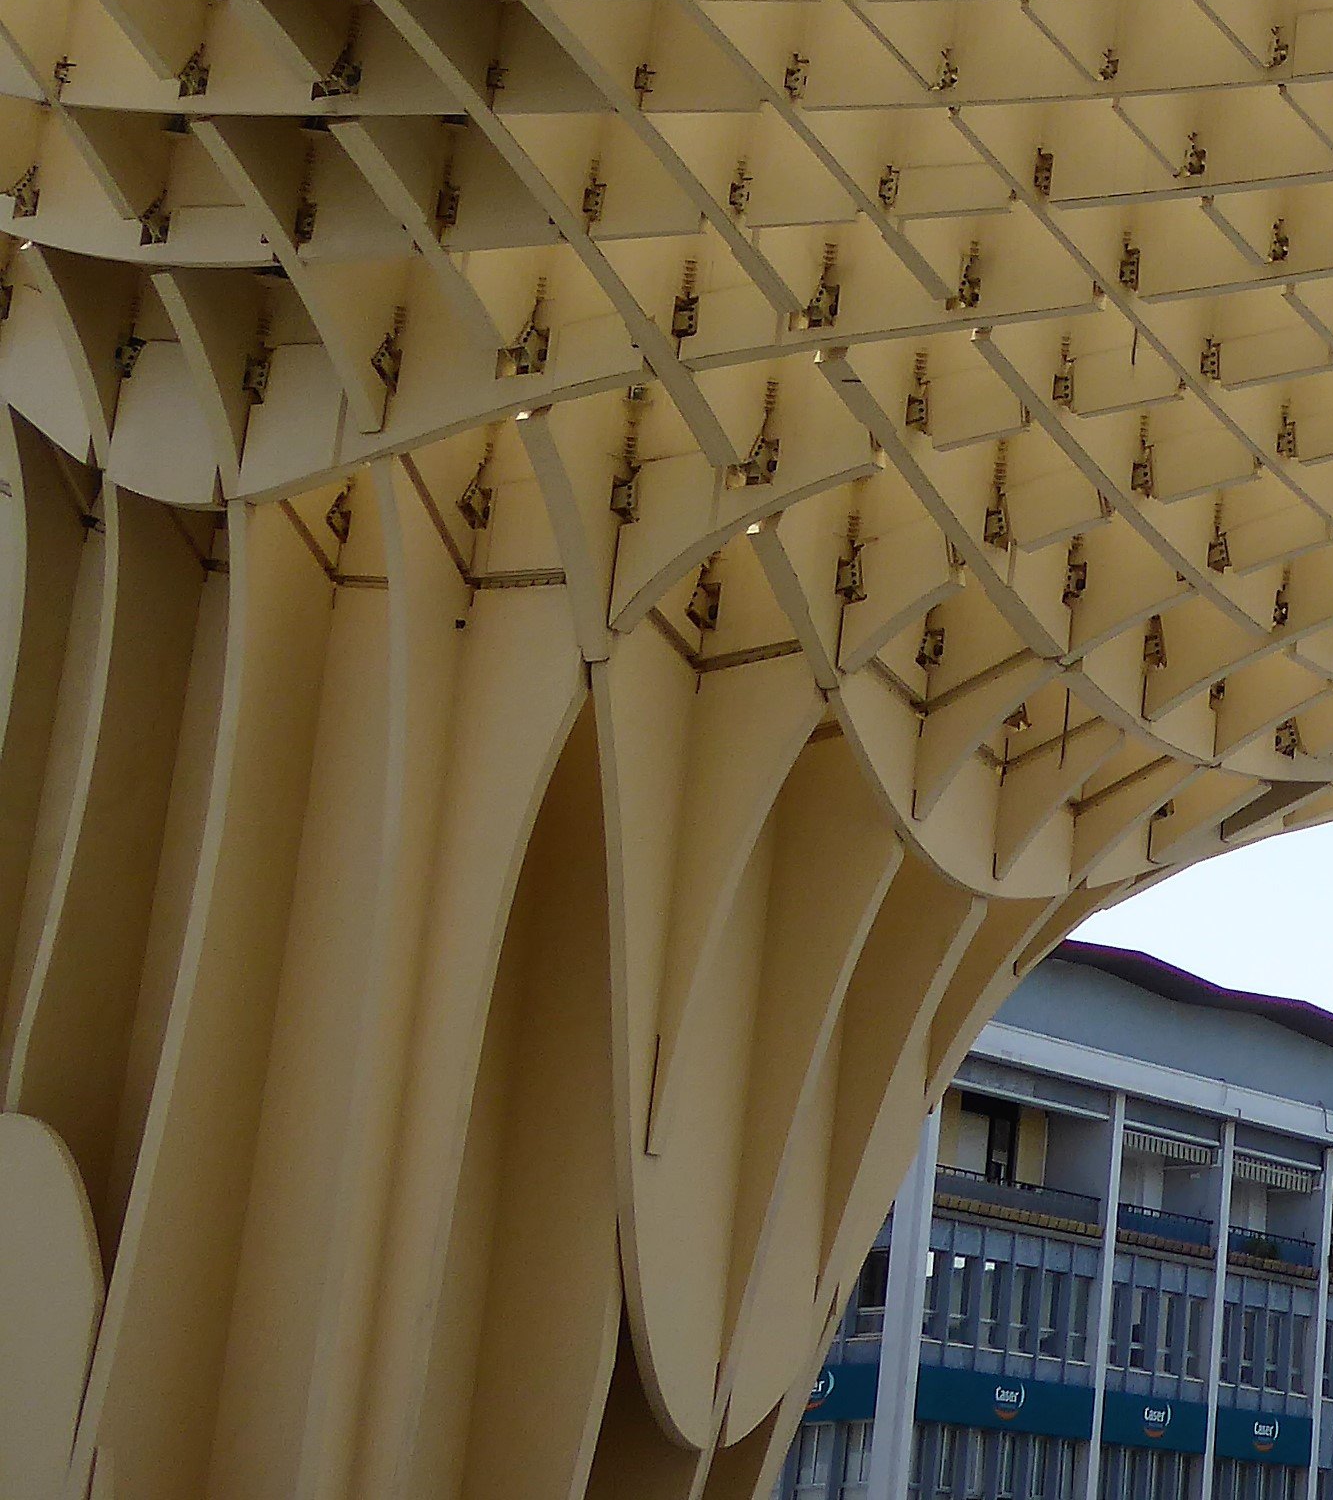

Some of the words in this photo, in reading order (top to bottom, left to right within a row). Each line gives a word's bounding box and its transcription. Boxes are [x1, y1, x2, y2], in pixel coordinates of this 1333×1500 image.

[996, 1386, 1019, 1402] Caser
[1144, 1406, 1165, 1422] Caser
[1254, 1421, 1274, 1436] Caser
